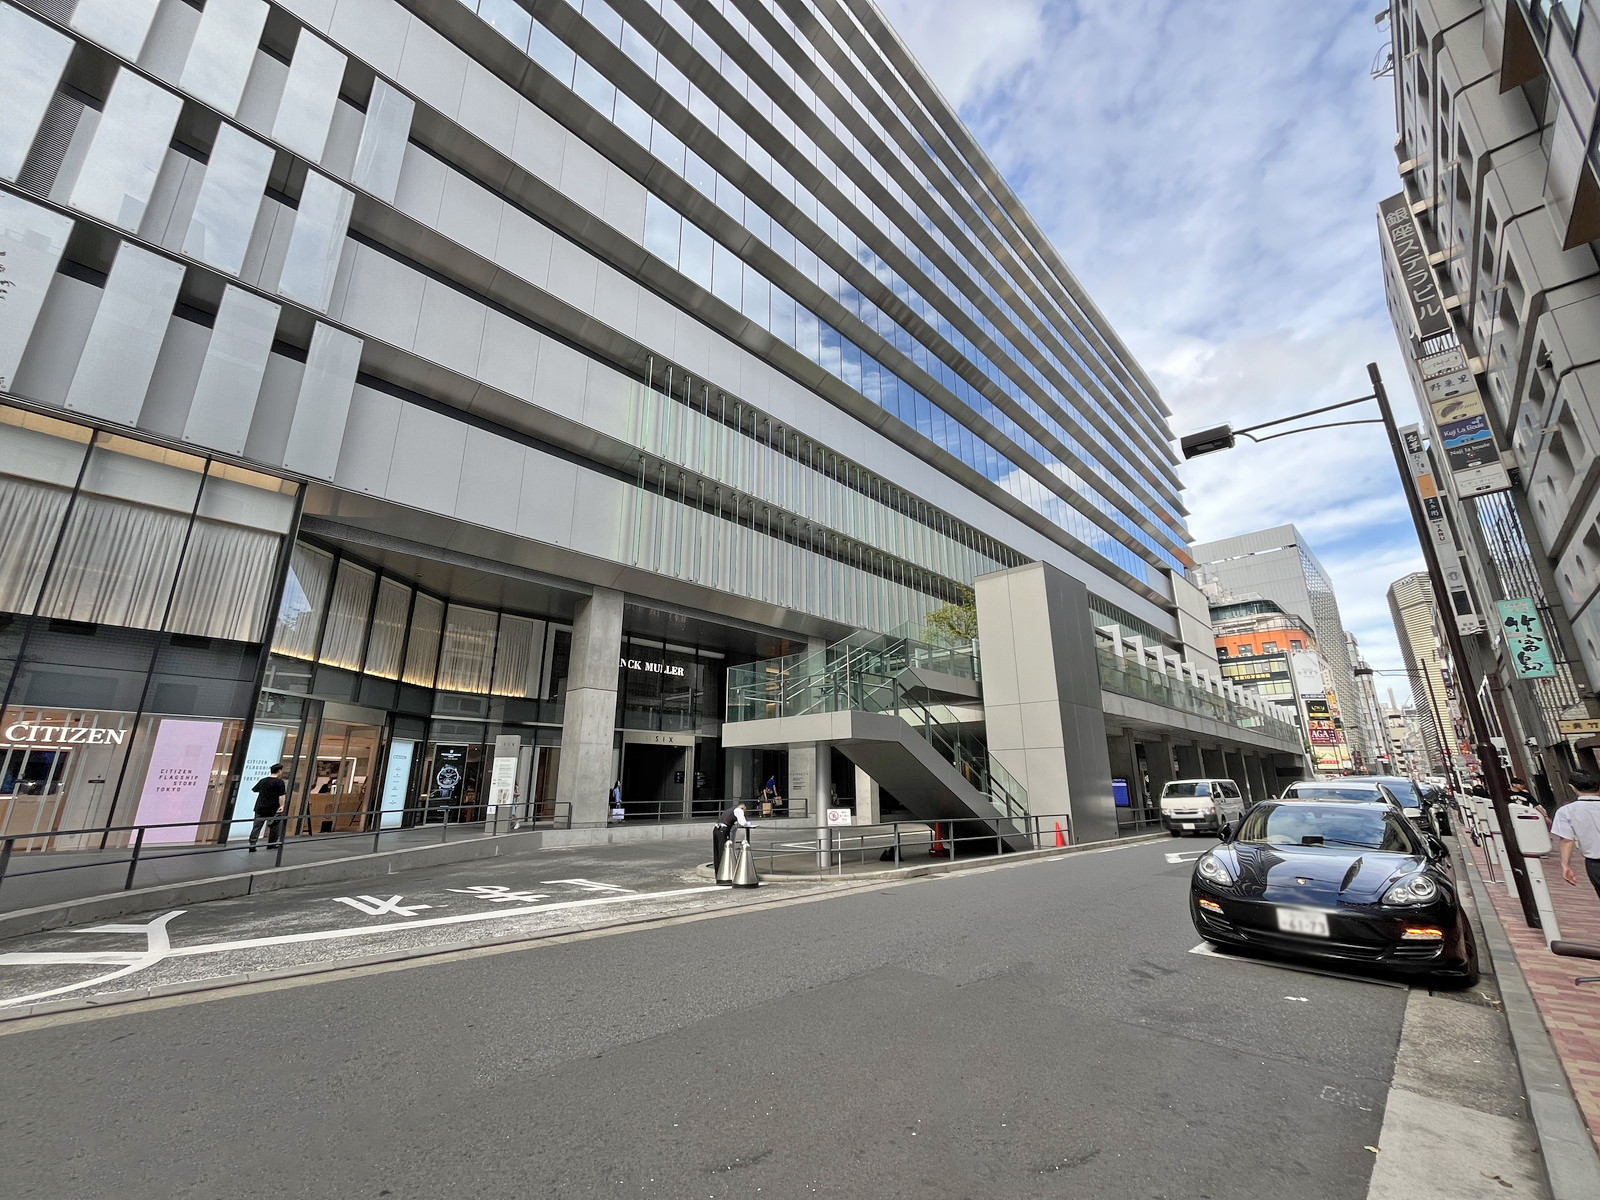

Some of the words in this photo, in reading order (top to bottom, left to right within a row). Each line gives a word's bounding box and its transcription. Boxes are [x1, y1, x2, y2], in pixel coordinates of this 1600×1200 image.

[1385, 206, 1442, 321] 銀座ステラビル
[5, 724, 127, 746] CITIZEN
[655, 735, 674, 743] SIX
[1311, 729, 1330, 738] AGA
